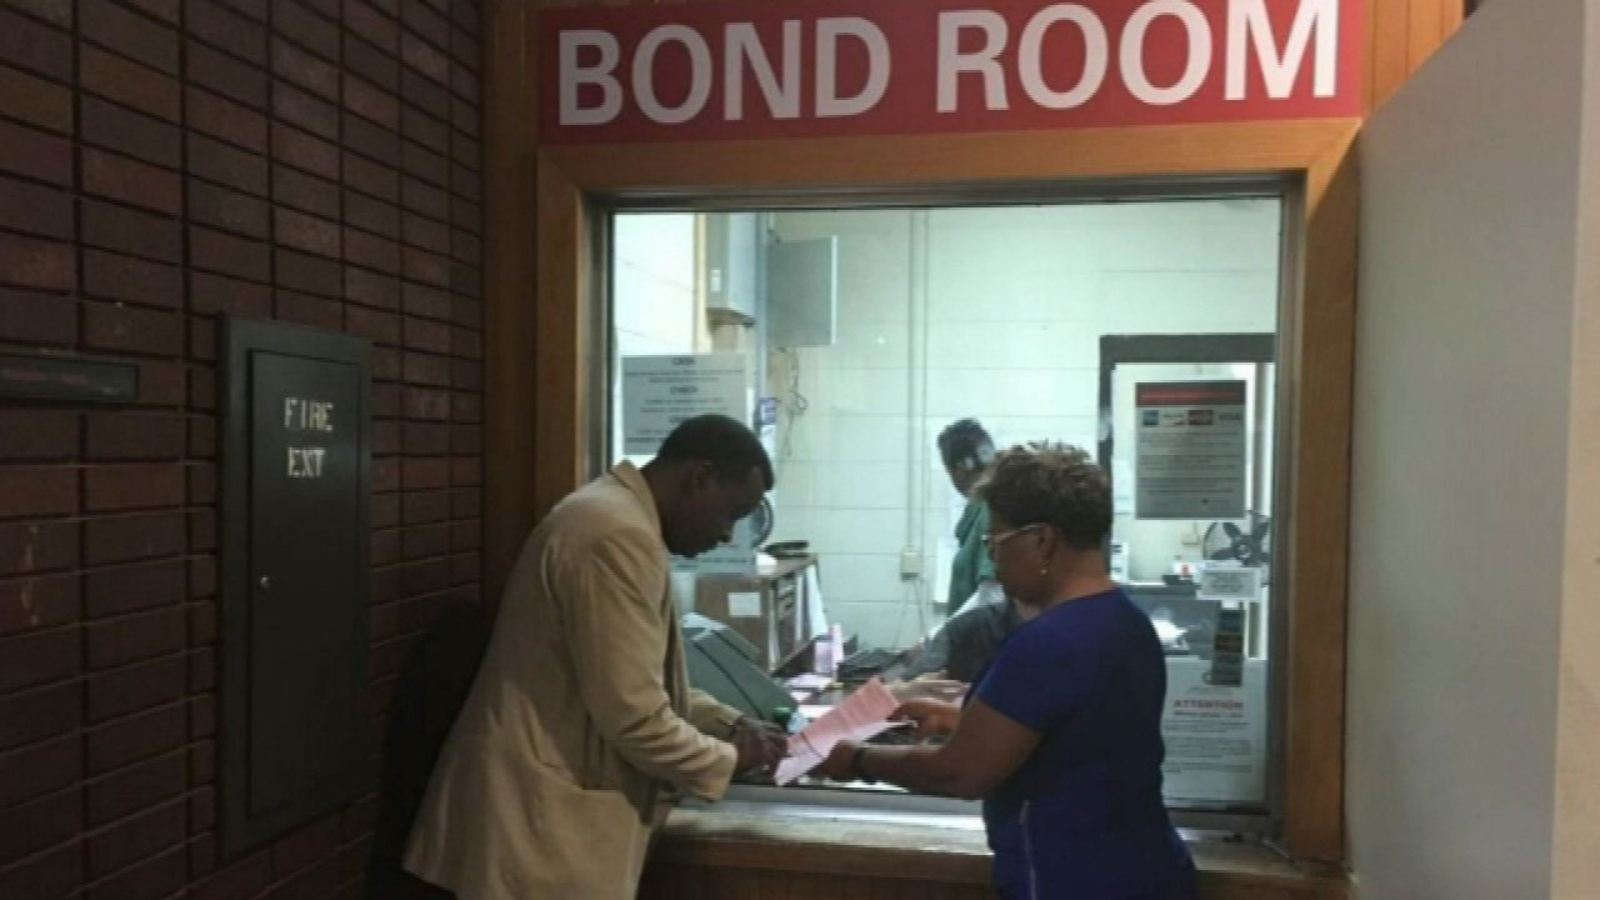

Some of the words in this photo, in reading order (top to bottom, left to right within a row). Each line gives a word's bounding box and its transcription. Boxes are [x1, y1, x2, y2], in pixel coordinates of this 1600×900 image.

[558, 16, 892, 126] BOND
[935, 0, 1338, 114] ROOM
[284, 397, 334, 431] FIRE
[287, 447, 326, 478] EXT
